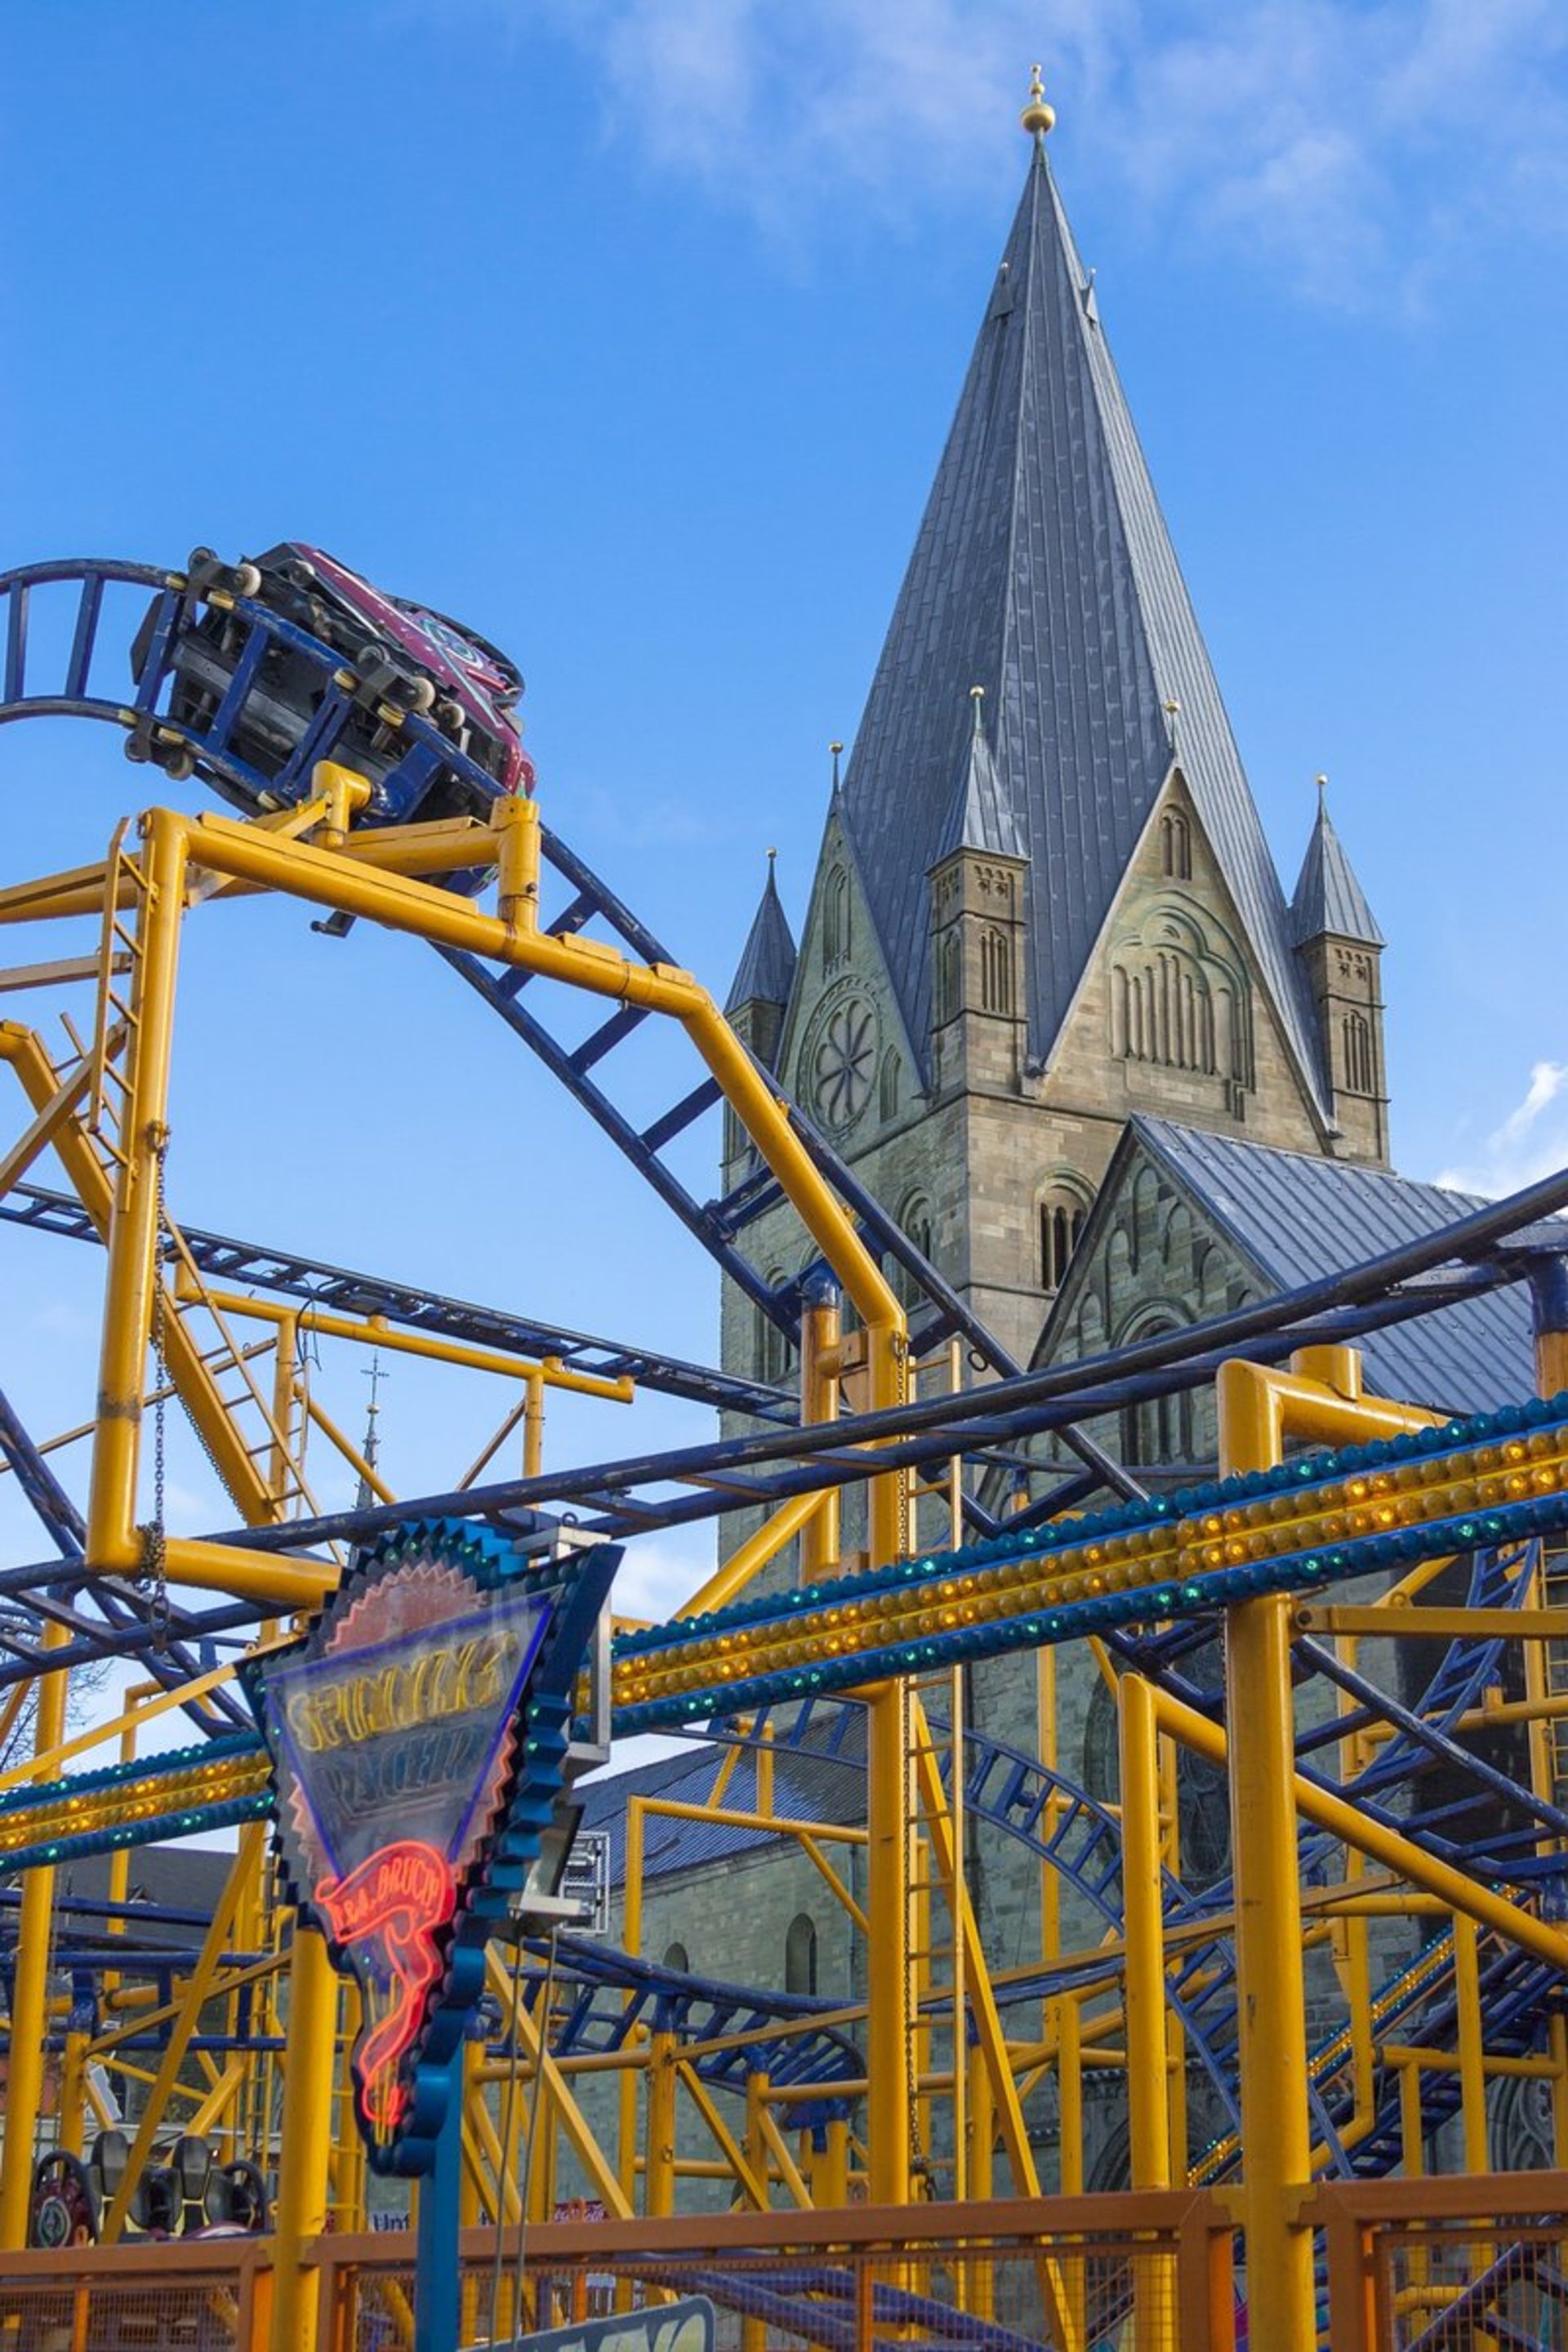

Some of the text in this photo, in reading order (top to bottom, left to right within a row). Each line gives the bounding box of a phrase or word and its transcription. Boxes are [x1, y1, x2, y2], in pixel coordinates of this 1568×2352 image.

[287, 1629, 518, 1751] SPINNING
[314, 1725, 482, 1816] RACER
[377, 1855, 439, 1907] BRUCH
